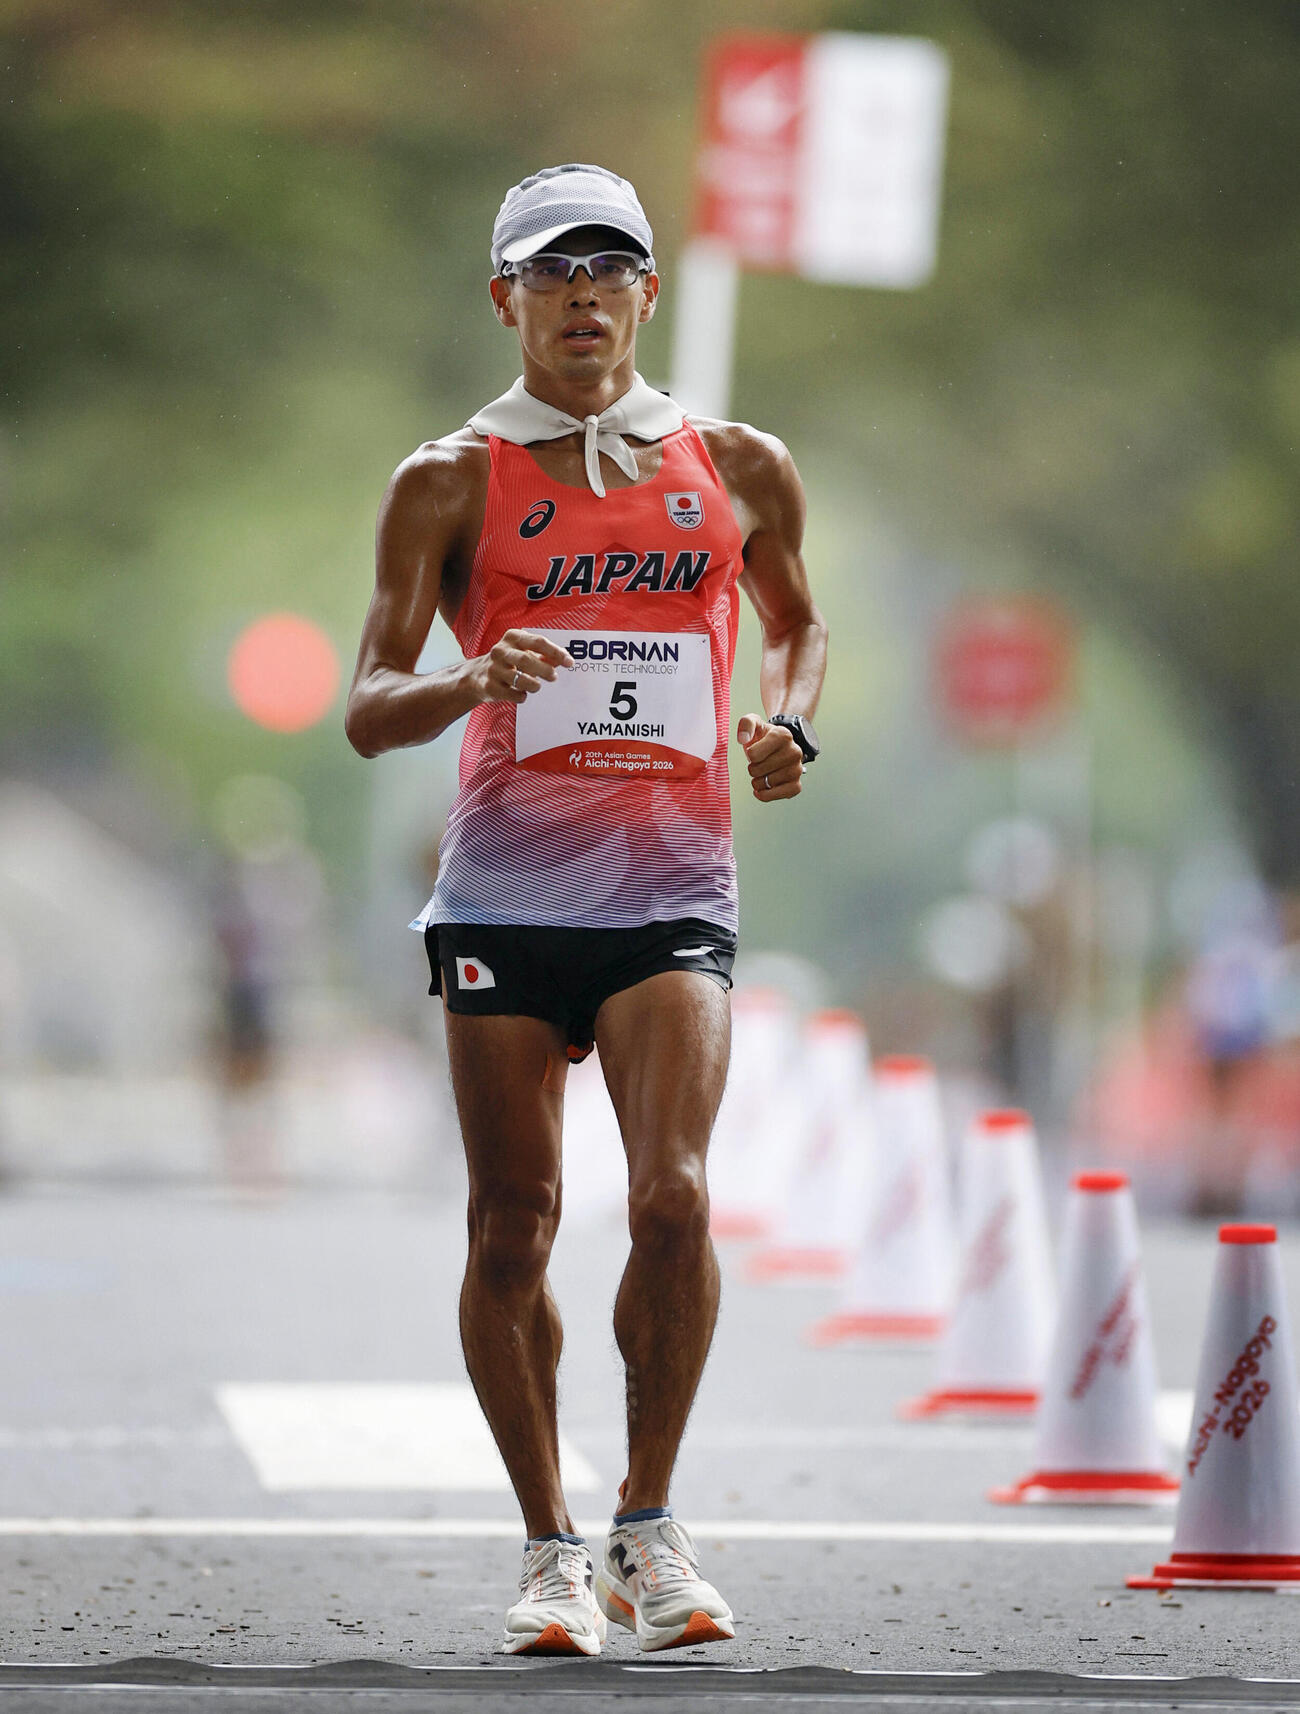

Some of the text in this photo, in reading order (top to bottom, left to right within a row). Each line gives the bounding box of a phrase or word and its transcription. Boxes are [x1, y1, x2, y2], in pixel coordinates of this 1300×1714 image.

[527, 551, 711, 601] JAPAN
[565, 639, 679, 662] BORNAN
[568, 662, 679, 675] SPORTS TECHNOLOGY
[609, 681, 638, 721] 5
[577, 721, 665, 737] YAMANISHI
[585, 759, 674, 771] Aichi-Nagoya 2026
[605, 751, 624, 759] Asian
[626, 752, 651, 760] Games
[1223, 1379, 1271, 1440] 2026
